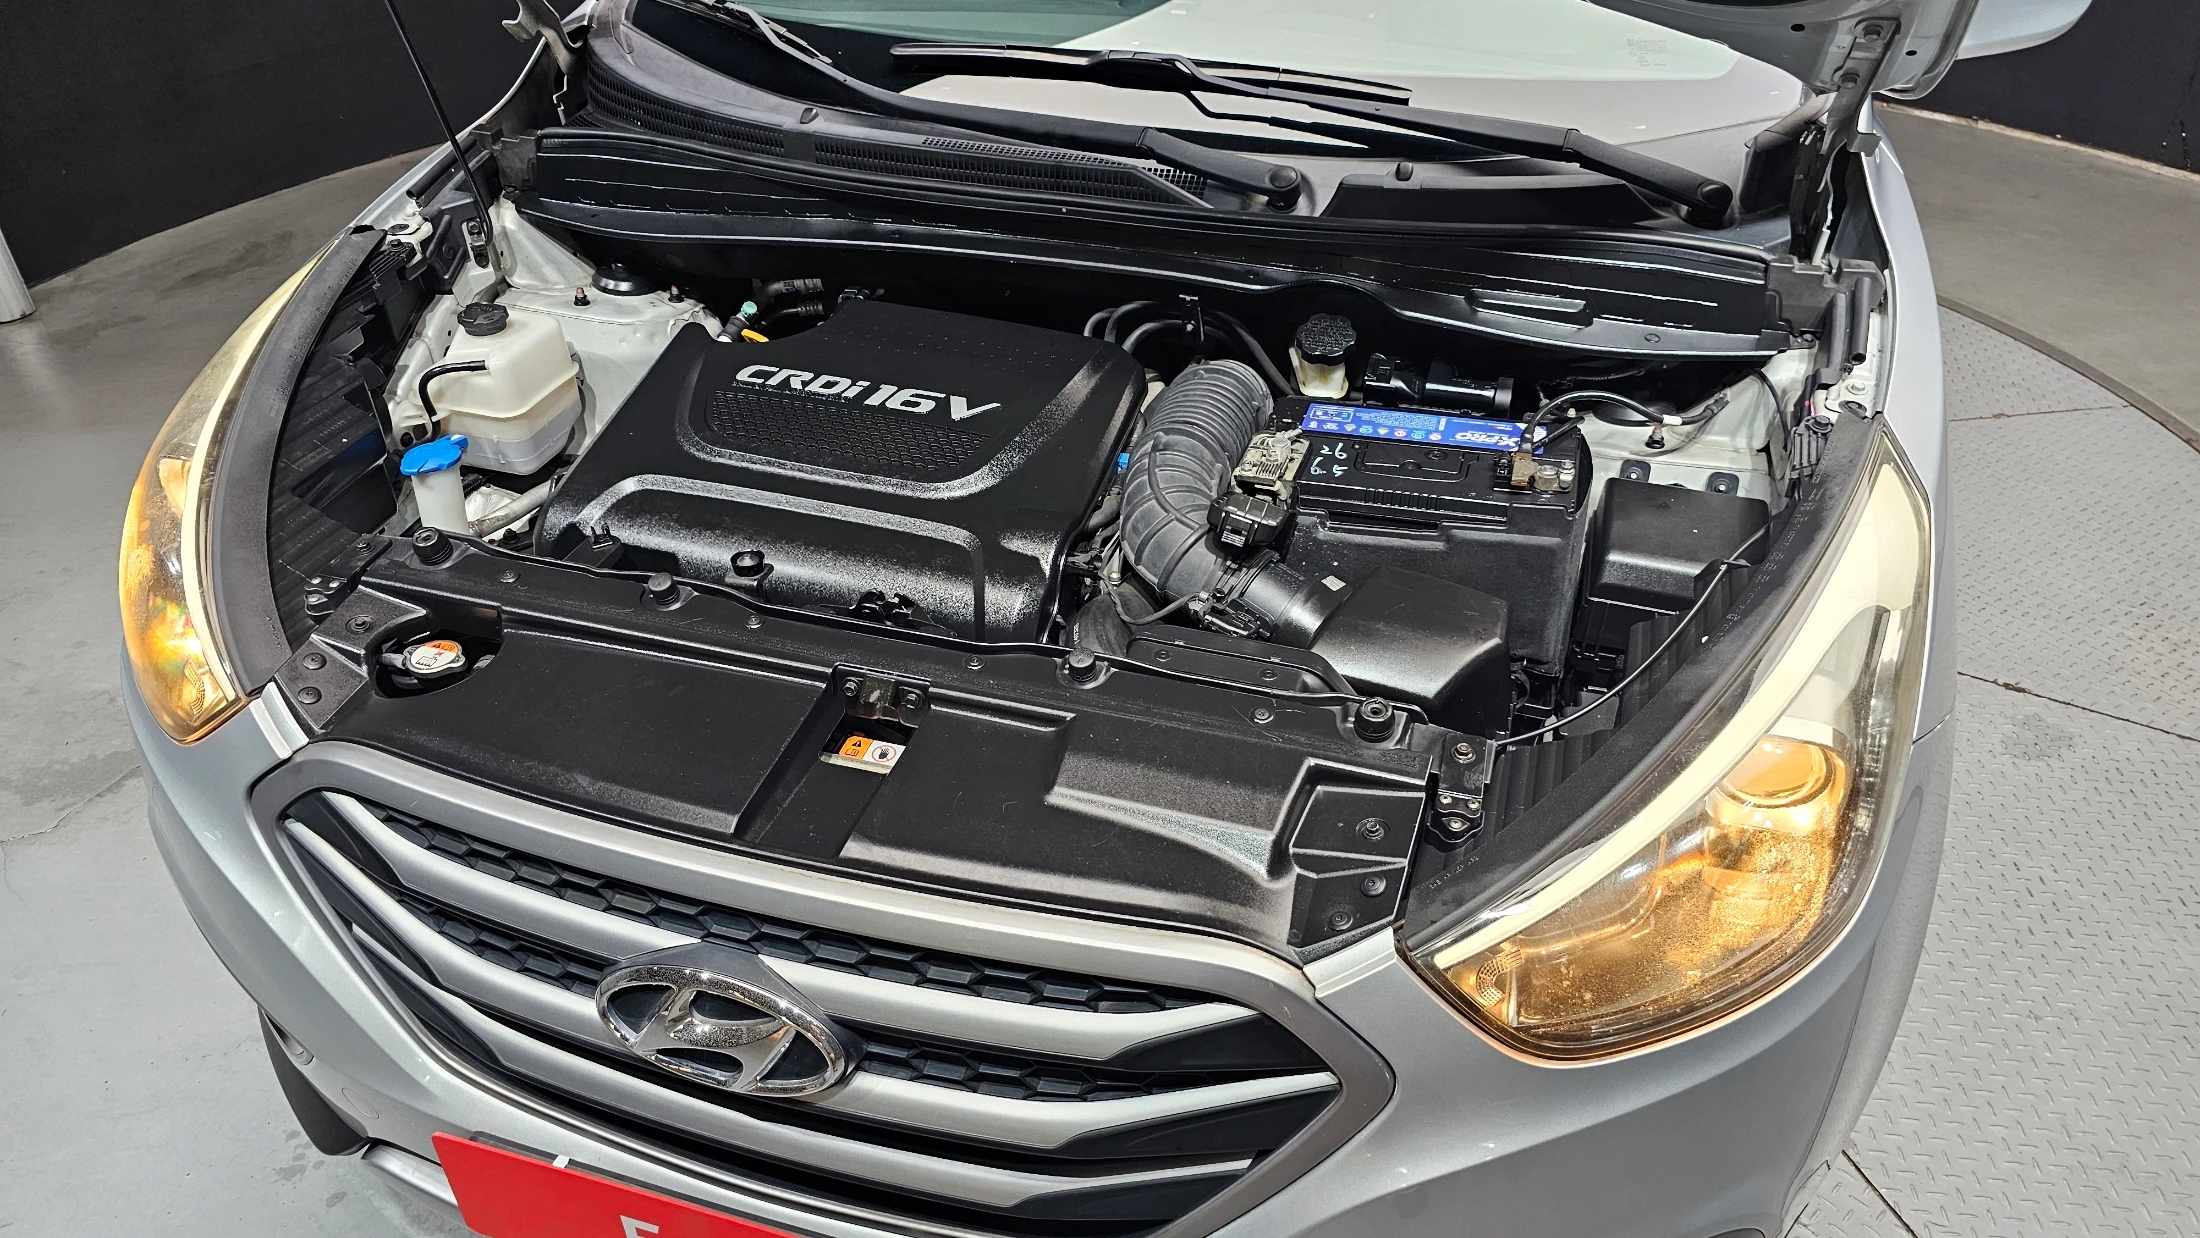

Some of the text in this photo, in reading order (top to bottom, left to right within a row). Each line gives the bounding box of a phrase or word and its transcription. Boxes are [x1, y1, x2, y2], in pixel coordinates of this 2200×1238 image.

[735, 364, 871, 399] CRDi
[863, 383, 1002, 422] 16V
[1319, 442, 1349, 460] 26
